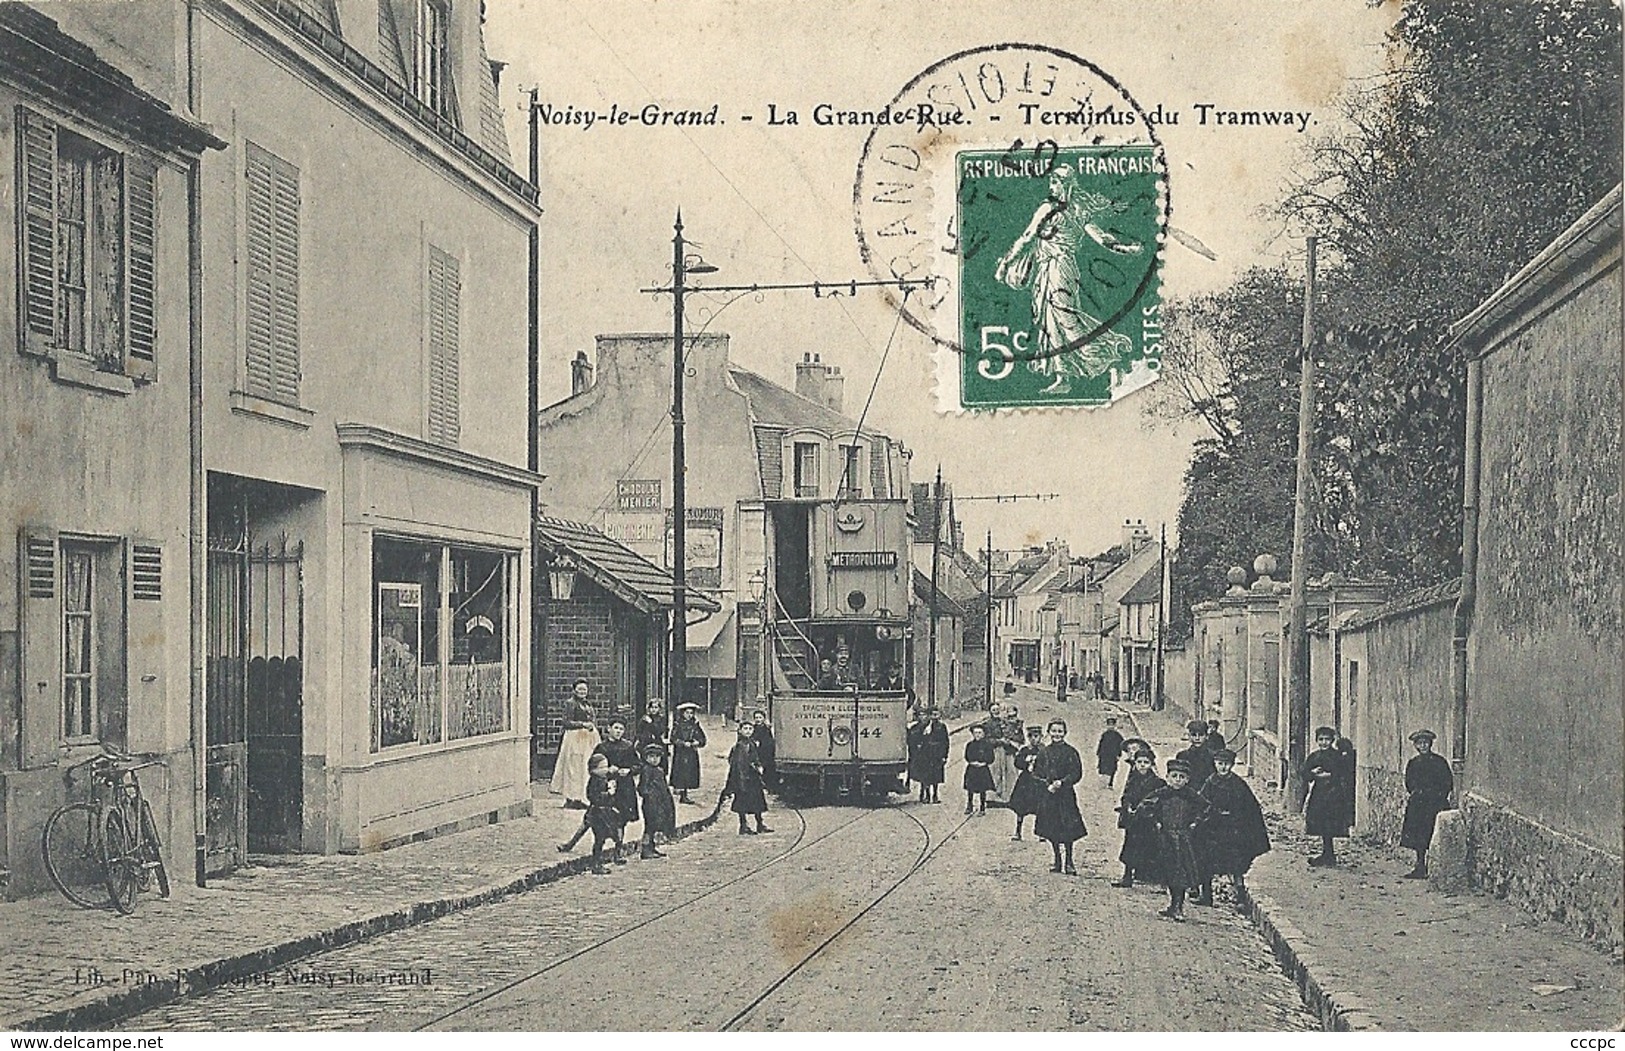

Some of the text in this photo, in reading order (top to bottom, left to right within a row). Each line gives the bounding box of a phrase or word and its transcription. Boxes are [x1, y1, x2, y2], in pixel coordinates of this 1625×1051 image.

[620, 497, 657, 509] MENIER
[831, 552, 895, 567] METROPOLITAIN
[860, 727, 882, 738] 44
